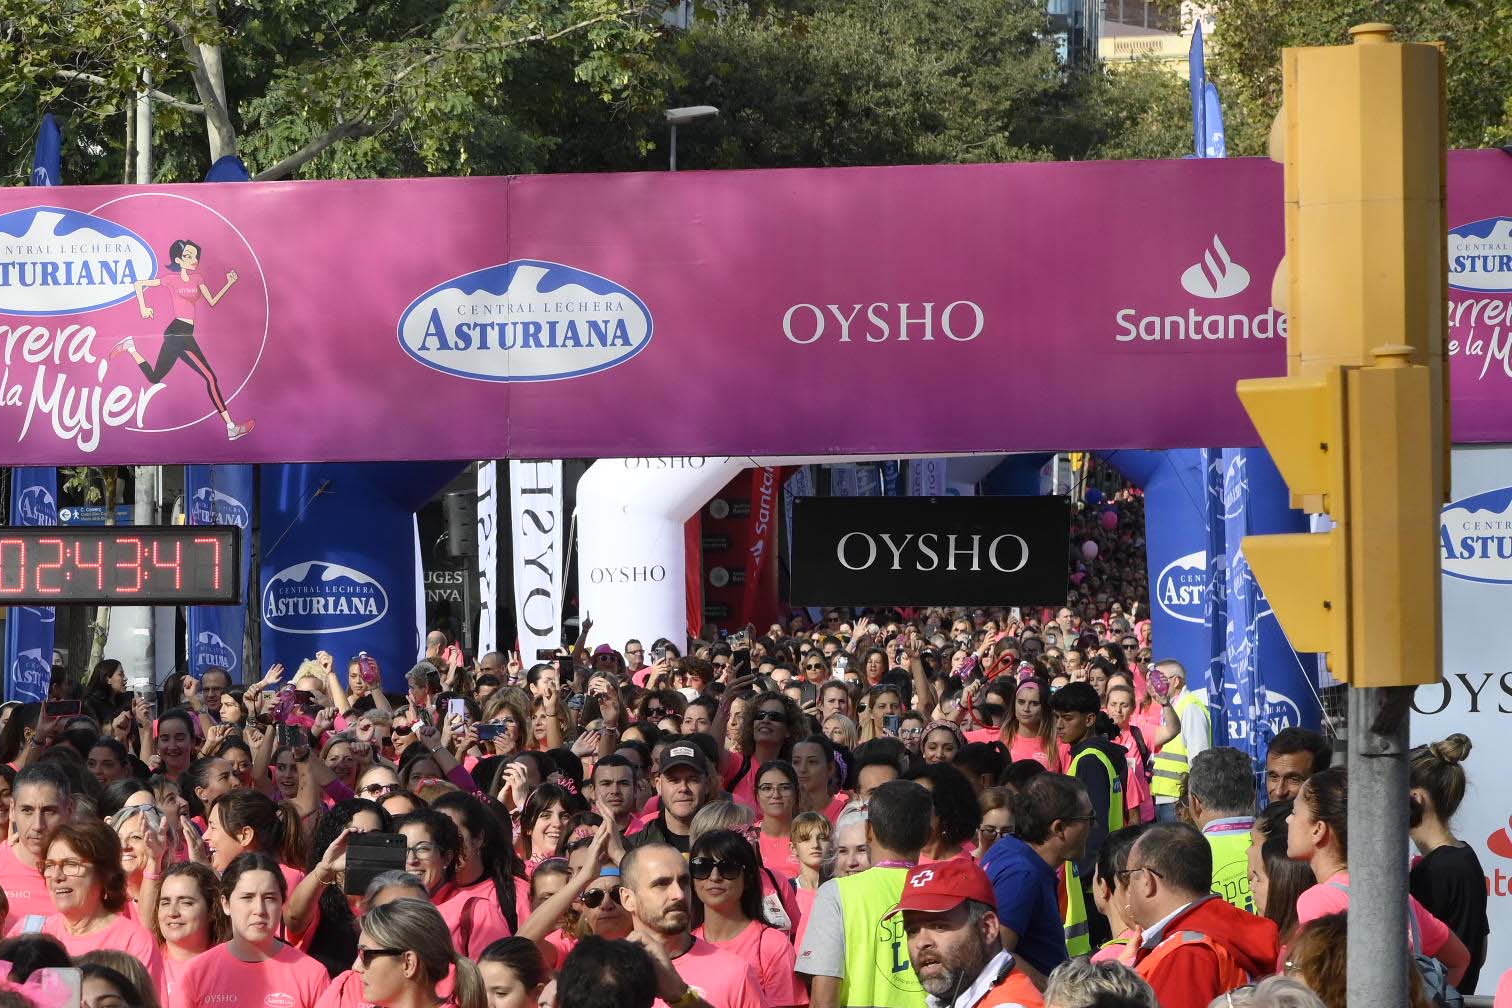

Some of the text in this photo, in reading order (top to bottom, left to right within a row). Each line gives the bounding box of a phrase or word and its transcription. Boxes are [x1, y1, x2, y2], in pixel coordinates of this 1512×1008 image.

[60, 243, 132, 254] LECHERA
[457, 301, 625, 316] CENTRAL LECHERA
[782, 300, 986, 345] OYSHO
[417, 307, 634, 351] ASTURIANA
[1115, 306, 1289, 342] Santande
[1466, 327, 1484, 356] la
[0, 367, 24, 408] la
[17, 359, 167, 453] Mujer
[836, 531, 1030, 574] OYSHO
[590, 564, 667, 585] OYSHO
[1180, 574, 1206, 583] CENT
[325, 585, 375, 594] LECHERA
[265, 591, 380, 619] ASTURIANA
[1410, 672, 1512, 715] OYS
